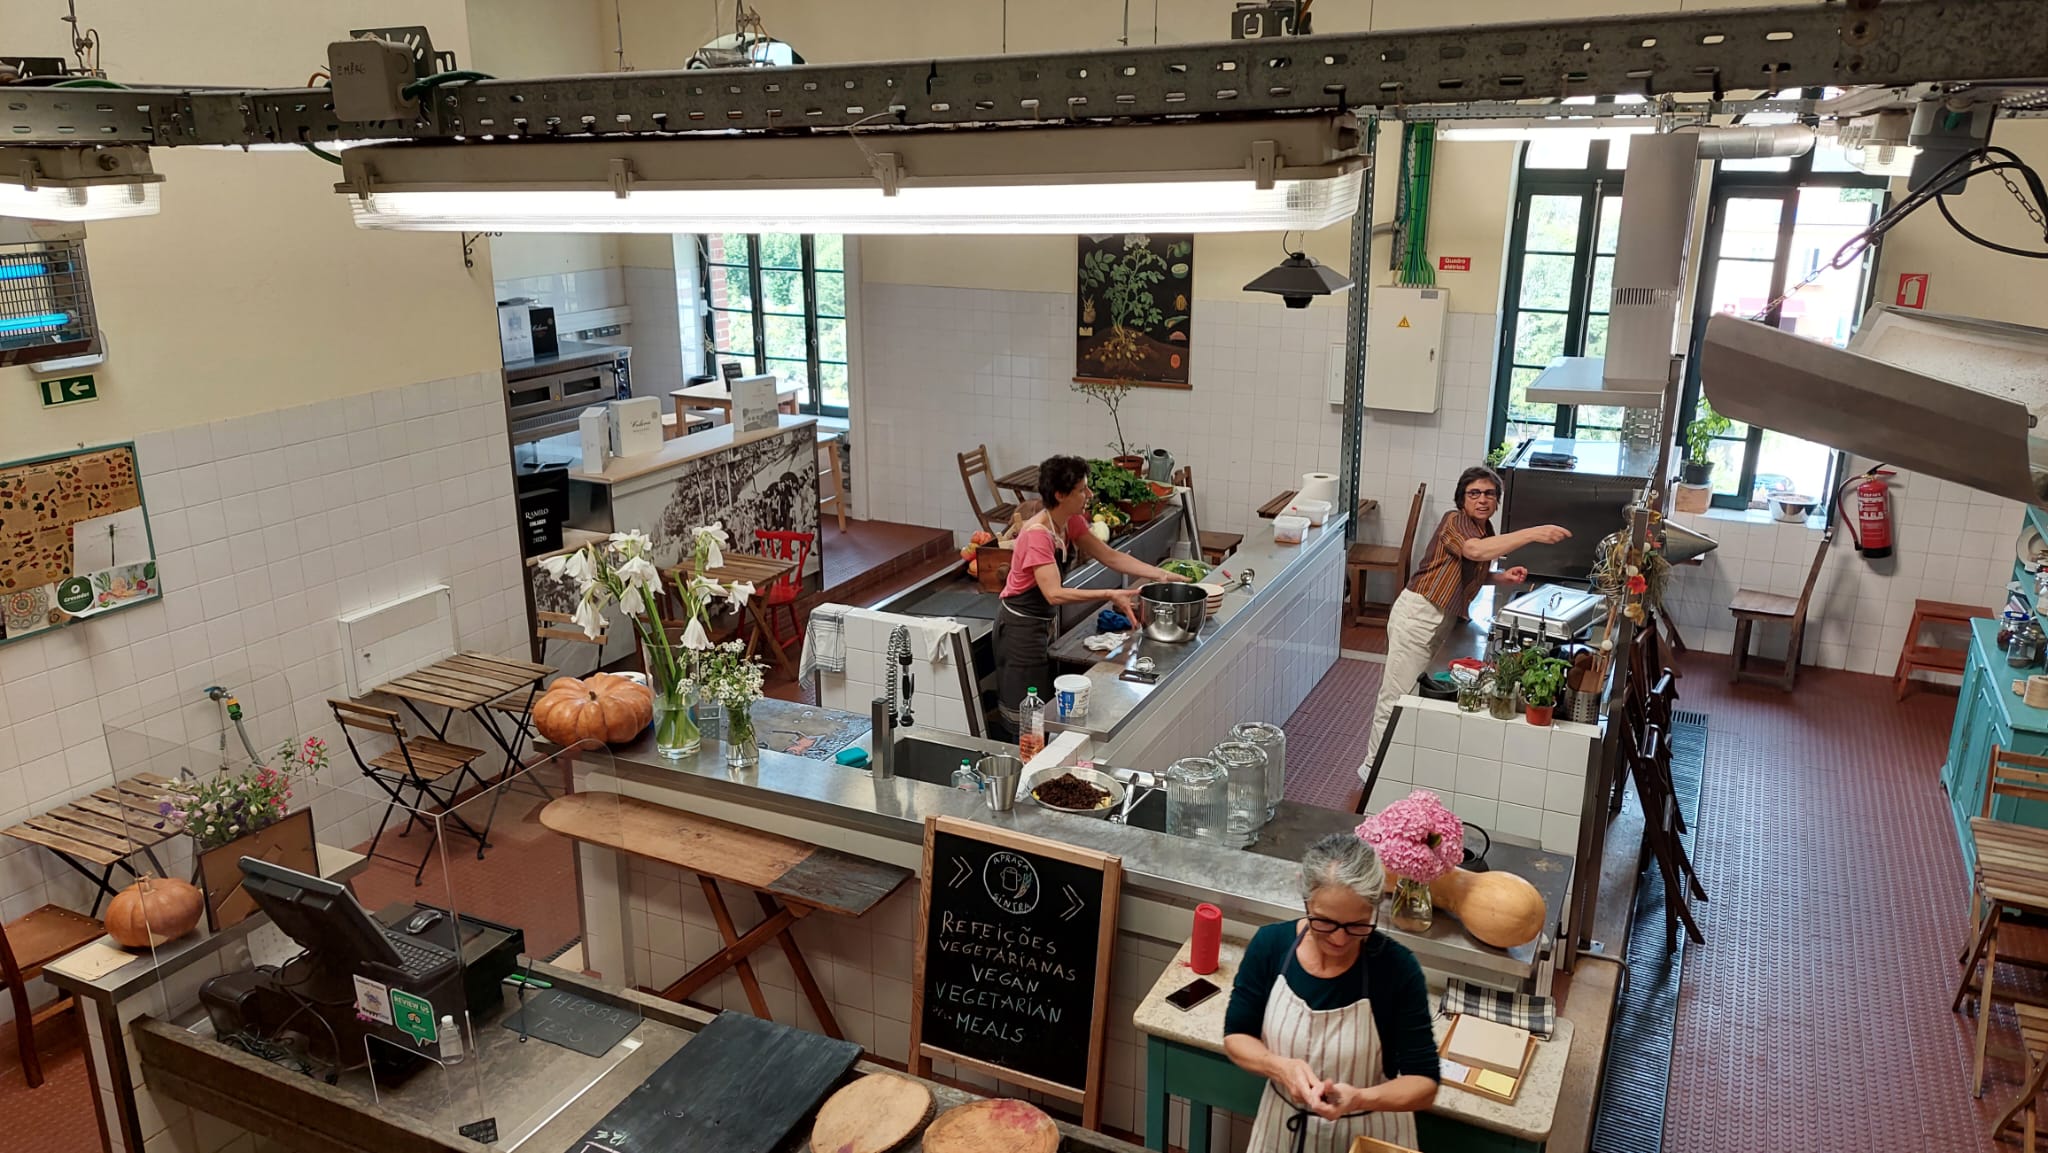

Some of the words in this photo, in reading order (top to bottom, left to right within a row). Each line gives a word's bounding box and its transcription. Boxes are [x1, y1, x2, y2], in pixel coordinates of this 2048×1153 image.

[971, 963, 1040, 993] VEGAN
[549, 994, 633, 1029] HERBAL
[935, 981, 1062, 1023] VEGETARIAN
[955, 1012, 1025, 1043] MEALS
